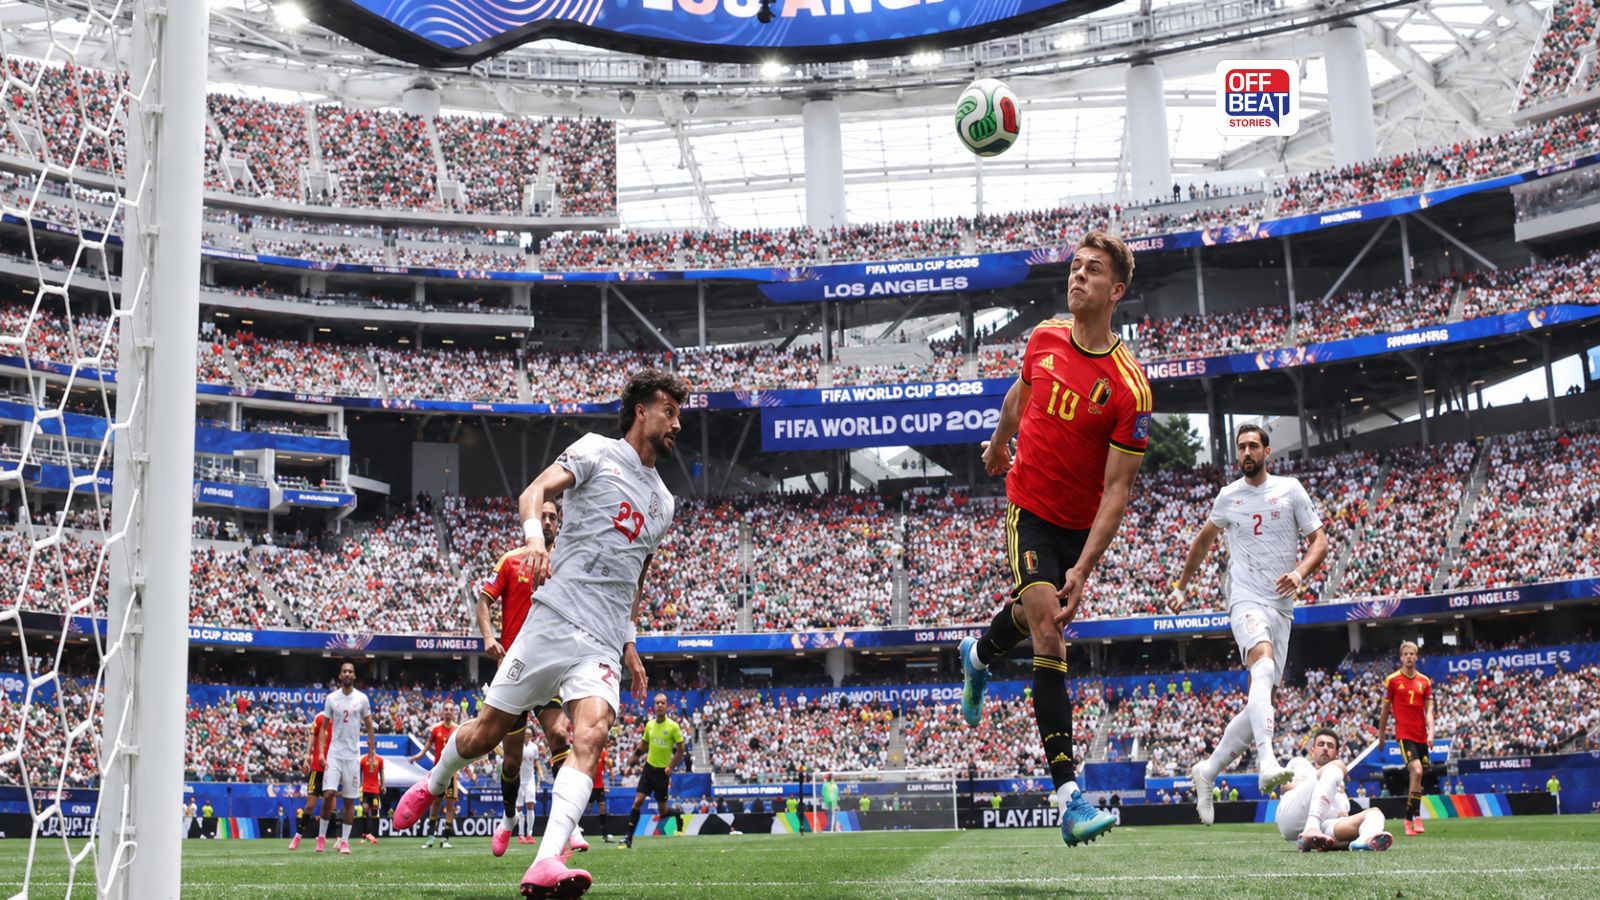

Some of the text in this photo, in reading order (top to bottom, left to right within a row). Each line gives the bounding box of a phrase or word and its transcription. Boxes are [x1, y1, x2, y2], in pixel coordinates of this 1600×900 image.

[865, 258, 980, 275] FIFA WORLD CUP 2026
[824, 276, 969, 298] LOS ANGELES
[1146, 360, 1206, 379] NGELES
[821, 381, 984, 403] FIFA WORLD CUP 2026
[1046, 380, 1080, 421] 10
[774, 408, 1001, 439] FIFA WORLD CUP 202
[1253, 514, 1263, 536] 2
[1449, 590, 1521, 608] LOS ANGELES
[1153, 619, 1174, 631] FIFA
[1175, 617, 1211, 629] WORLD
[202, 629, 221, 640] CUP
[915, 631, 934, 642] LOS
[416, 639, 478, 650] LOS ANGELES
[1448, 657, 1483, 673] LOS
[259, 691, 302, 704] WORLD
[849, 690, 899, 702] WORLD
[901, 688, 929, 701] CUP
[931, 687, 964, 701] 202
[1408, 690, 1415, 705] 7
[343, 710, 349, 723] 2
